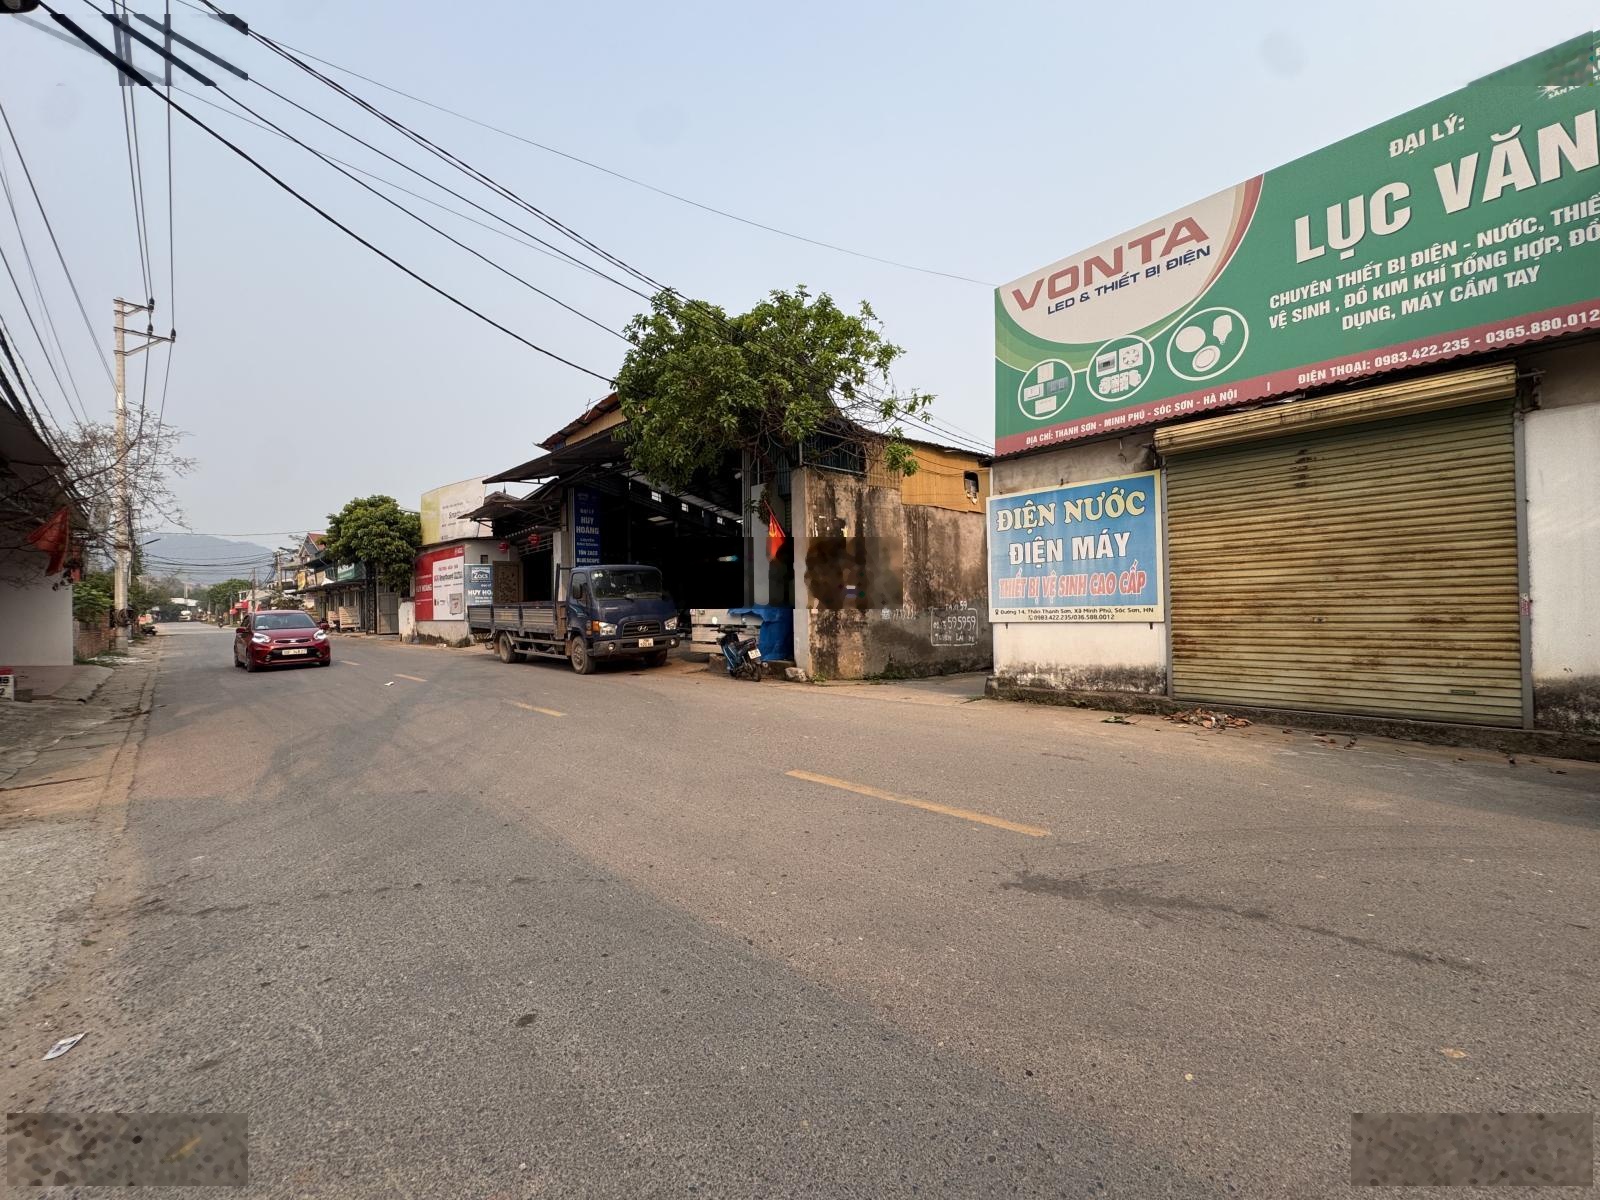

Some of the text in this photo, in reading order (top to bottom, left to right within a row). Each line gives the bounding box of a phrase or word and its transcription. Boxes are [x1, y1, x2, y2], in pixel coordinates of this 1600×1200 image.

[1389, 113, 1465, 158] ĐẠI LÝ:
[1294, 109, 1600, 264] LỤC VĂN
[1011, 217, 1210, 311] VONTA
[1047, 245, 1210, 315] LED & THIẾT BỊ ĐIỆN
[1269, 279, 1332, 309] CHUYÊN
[1336, 259, 1382, 289] THIẾT
[1387, 254, 1406, 275] BỊ
[1410, 240, 1457, 266] ĐIỆN
[1477, 217, 1544, 249] NƯỚC,
[1269, 310, 1287, 330] VỆ
[1292, 300, 1330, 323] SINH
[1344, 285, 1369, 309] ĐỒ
[1373, 278, 1409, 301] KIM
[1413, 264, 1447, 290] KHÍ
[1451, 251, 1508, 279] TỔNG
[1514, 234, 1562, 261] HỢP,
[1342, 264, 1540, 332] DỤNG, MÁY CẦM TAY
[1298, 307, 1600, 386] ĐIỆN THOẠI: 0983.422.235 0365.880.012
[1026, 436, 1039, 447] ĐỊA
[1055, 427, 1079, 440] THANH
[1080, 421, 1097, 433] SƠN
[1104, 414, 1126, 428] MINH
[1153, 403, 1172, 416] SÓC
[1174, 398, 1194, 412] SƠN
[1203, 391, 1217, 405] HÀ
[1219, 388, 1238, 402] NỘI
[995, 486, 1146, 535] ĐIỆN NƯỚC
[999, 559, 1147, 605] THIẾT BỊ VỆ SINH CAO CẤP
[1008, 528, 1131, 568] ĐIỆN MÁY
[467, 589, 480, 597] HUY
